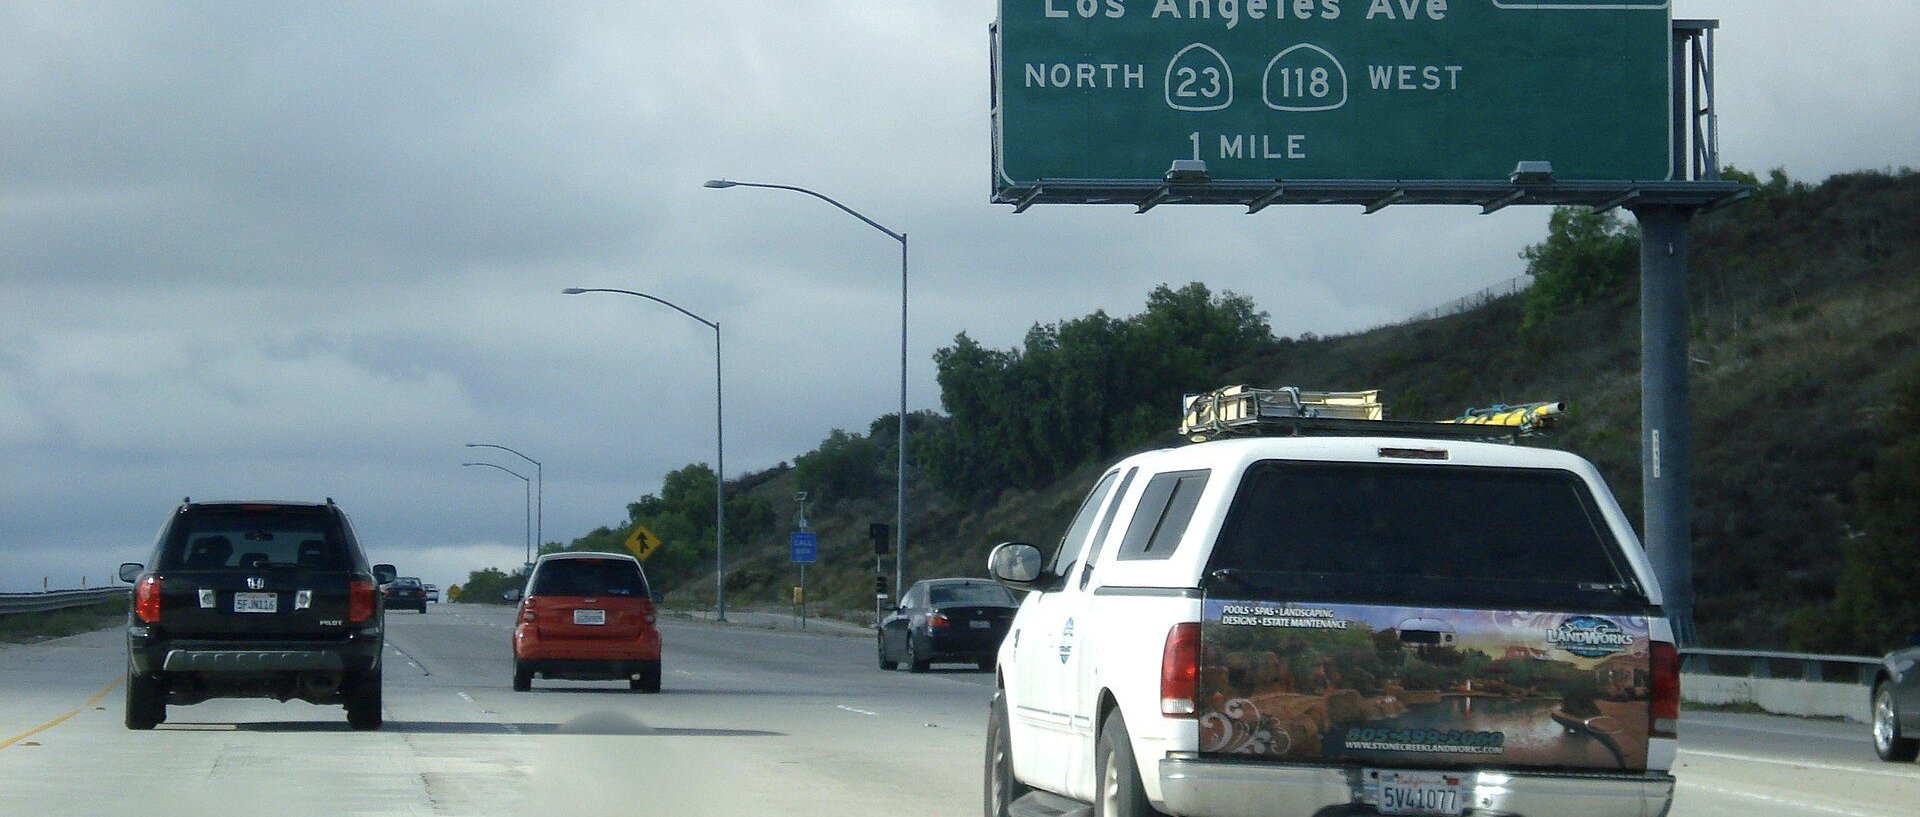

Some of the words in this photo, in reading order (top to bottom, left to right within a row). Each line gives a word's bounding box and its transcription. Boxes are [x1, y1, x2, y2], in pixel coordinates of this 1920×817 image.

[1044, 0, 1125, 18] Los
[1151, 0, 1340, 30] Angeles
[1366, 0, 1448, 20] Ave
[1024, 63, 1145, 89] NORTH
[1176, 66, 1222, 98] 23
[1281, 66, 1330, 98] 118
[1369, 64, 1463, 90] WEST
[1189, 132, 1201, 160] 1
[1220, 134, 1306, 160] MILE
[1222, 605, 1250, 615] POOLS
[1254, 607, 1275, 616] SPAS
[1279, 608, 1334, 618] LANDSCAPING
[1222, 616, 1258, 626] DESIGNS
[1262, 617, 1291, 627] ESTATE
[1290, 619, 1348, 629] MAINTENANCE
[1384, 787, 1457, 810] 5V41077
